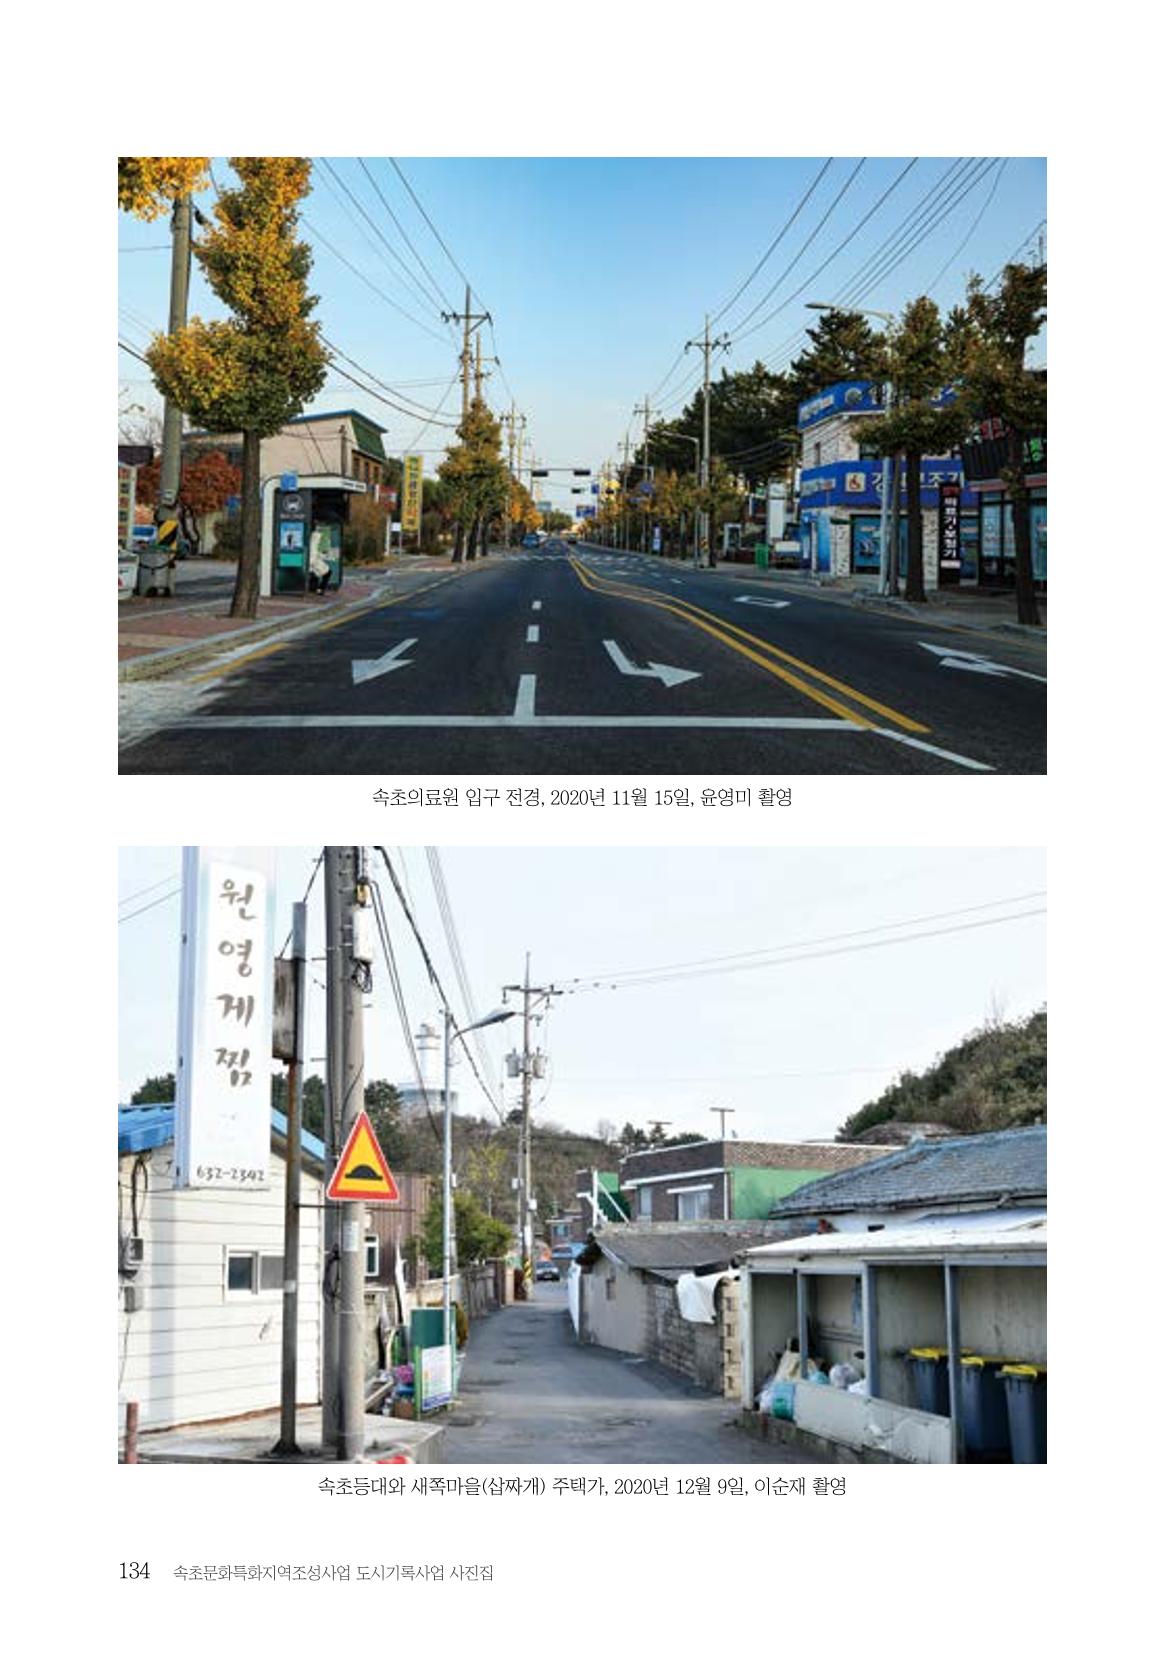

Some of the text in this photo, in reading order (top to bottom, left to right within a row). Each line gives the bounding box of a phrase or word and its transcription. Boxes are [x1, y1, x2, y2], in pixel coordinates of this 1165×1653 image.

[214, 878, 257, 1088] 원영게찜
[119, 1562, 151, 1580] 134
[173, 1564, 493, 1582] 속초문화특화지역조성사업 도시기록사업 사진집
